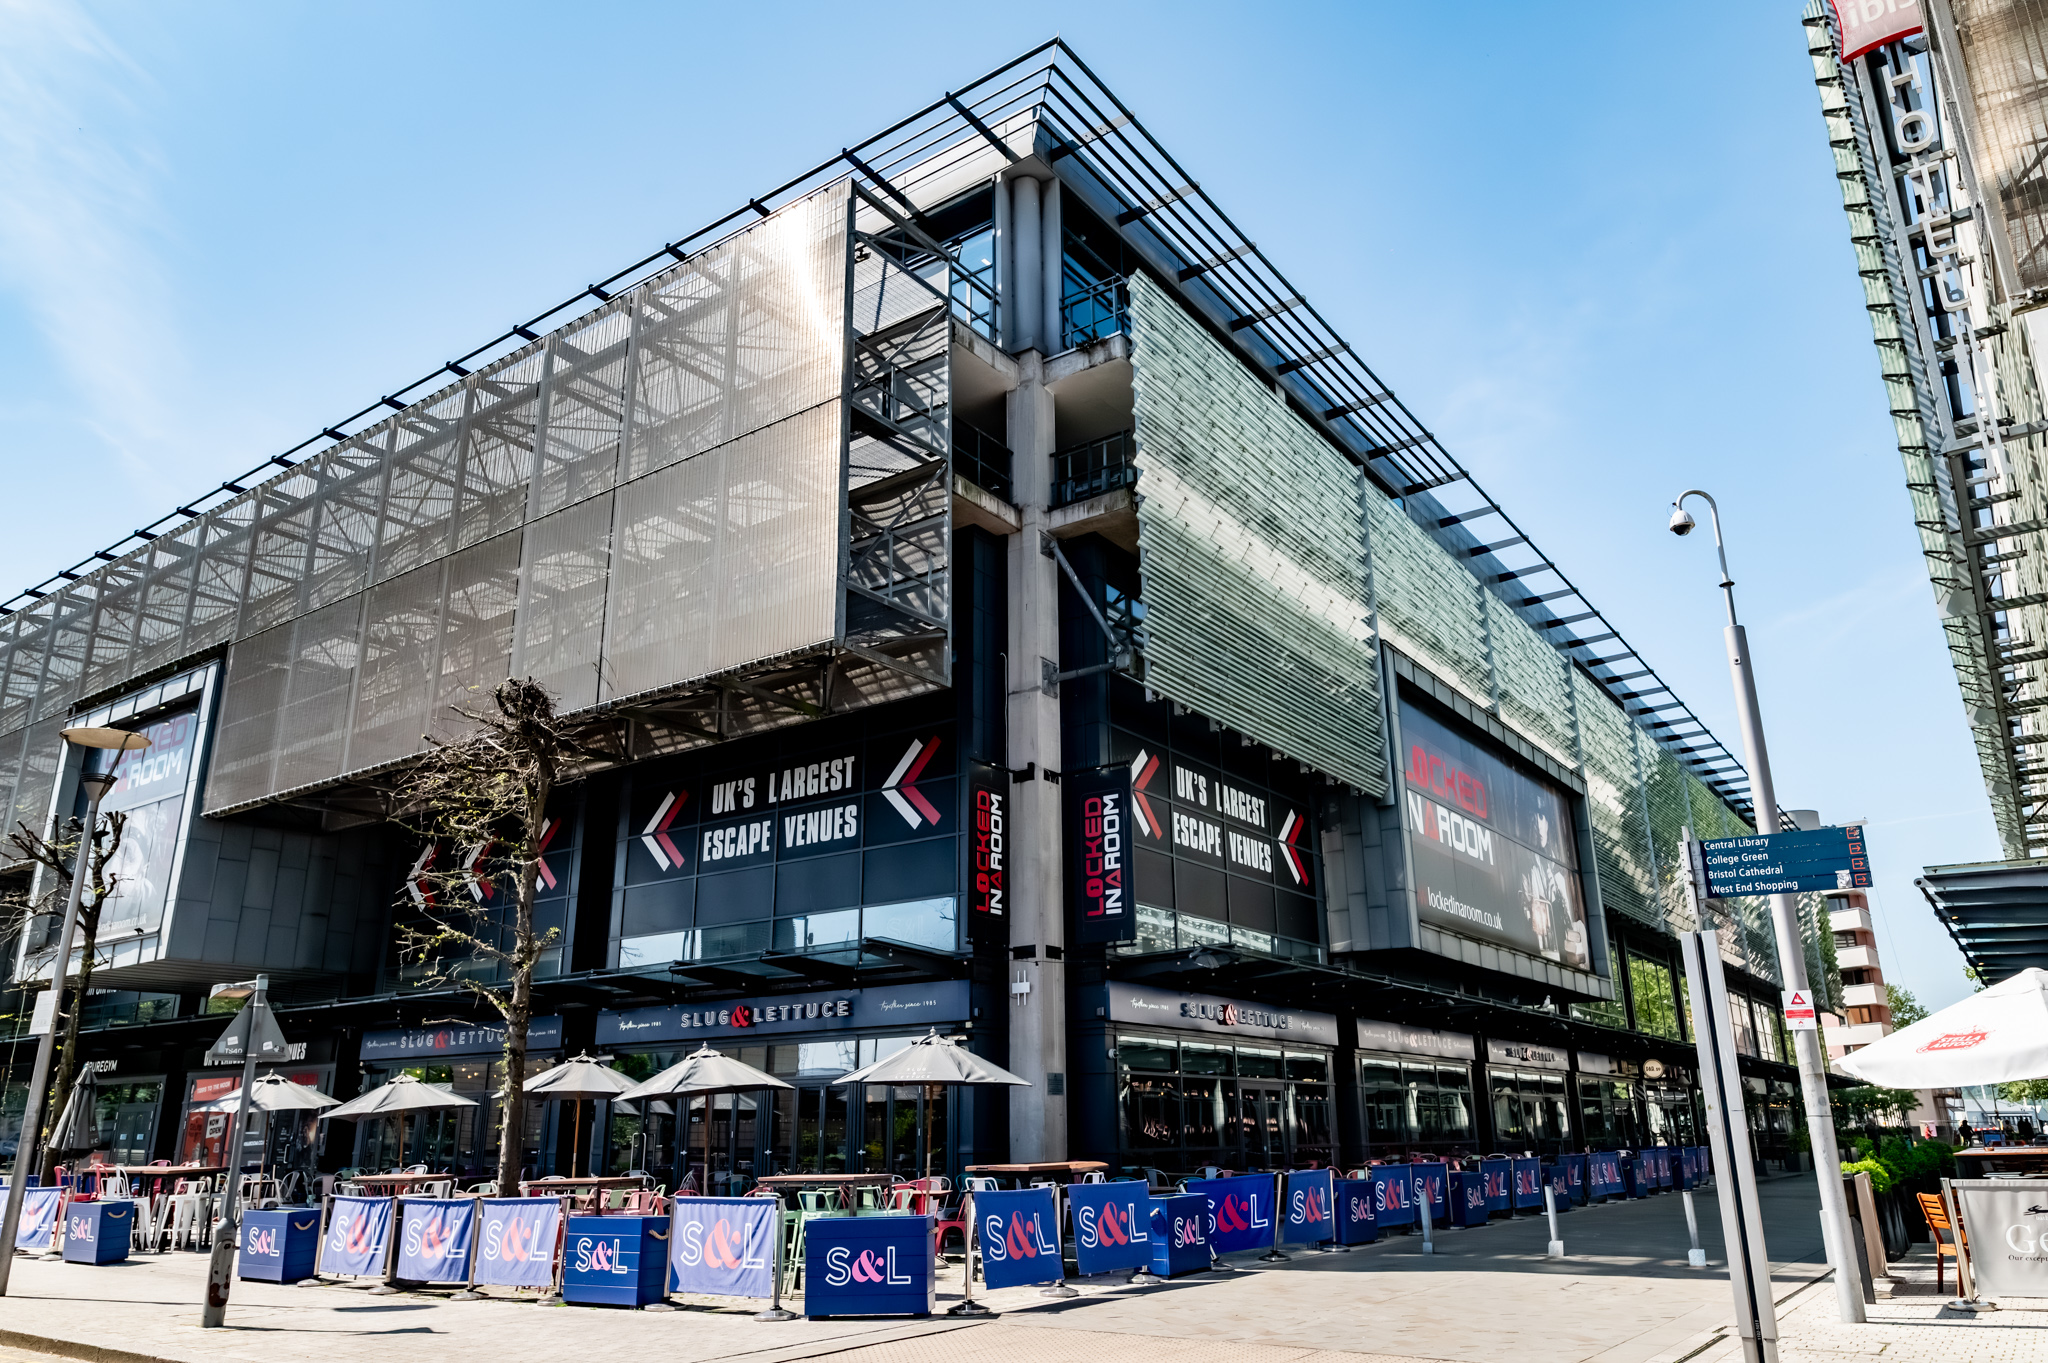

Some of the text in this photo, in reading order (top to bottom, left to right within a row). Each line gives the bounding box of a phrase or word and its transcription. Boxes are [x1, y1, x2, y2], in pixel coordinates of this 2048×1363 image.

[110, 748, 185, 795] AROOM
[711, 756, 855, 815] UK'S LARGEST
[1175, 765, 1266, 828] UK'S LARGEST
[702, 804, 857, 862] ESCAPE VENUES
[1173, 811, 1273, 874] ESCAPE VENUES
[1407, 789, 1494, 865] NAROOM
[1704, 838, 1769, 850] Central Library
[976, 789, 991, 912] LOCKED
[1085, 797, 1104, 917] LOCKED
[1706, 852, 1769, 865] College Green
[1708, 865, 1784, 880] Bristol Cathedral
[1710, 880, 1799, 894] West End Shopping
[1427, 886, 1504, 931] lockedinaroom.co.uk
[288, 1042, 307, 1060] NUES
[1929, 1040, 1977, 1049] ARTOIS
[1938, 1035, 1982, 1043] STELLA
[575, 1237, 627, 1275] S&L
[825, 1246, 911, 1287] S&L
